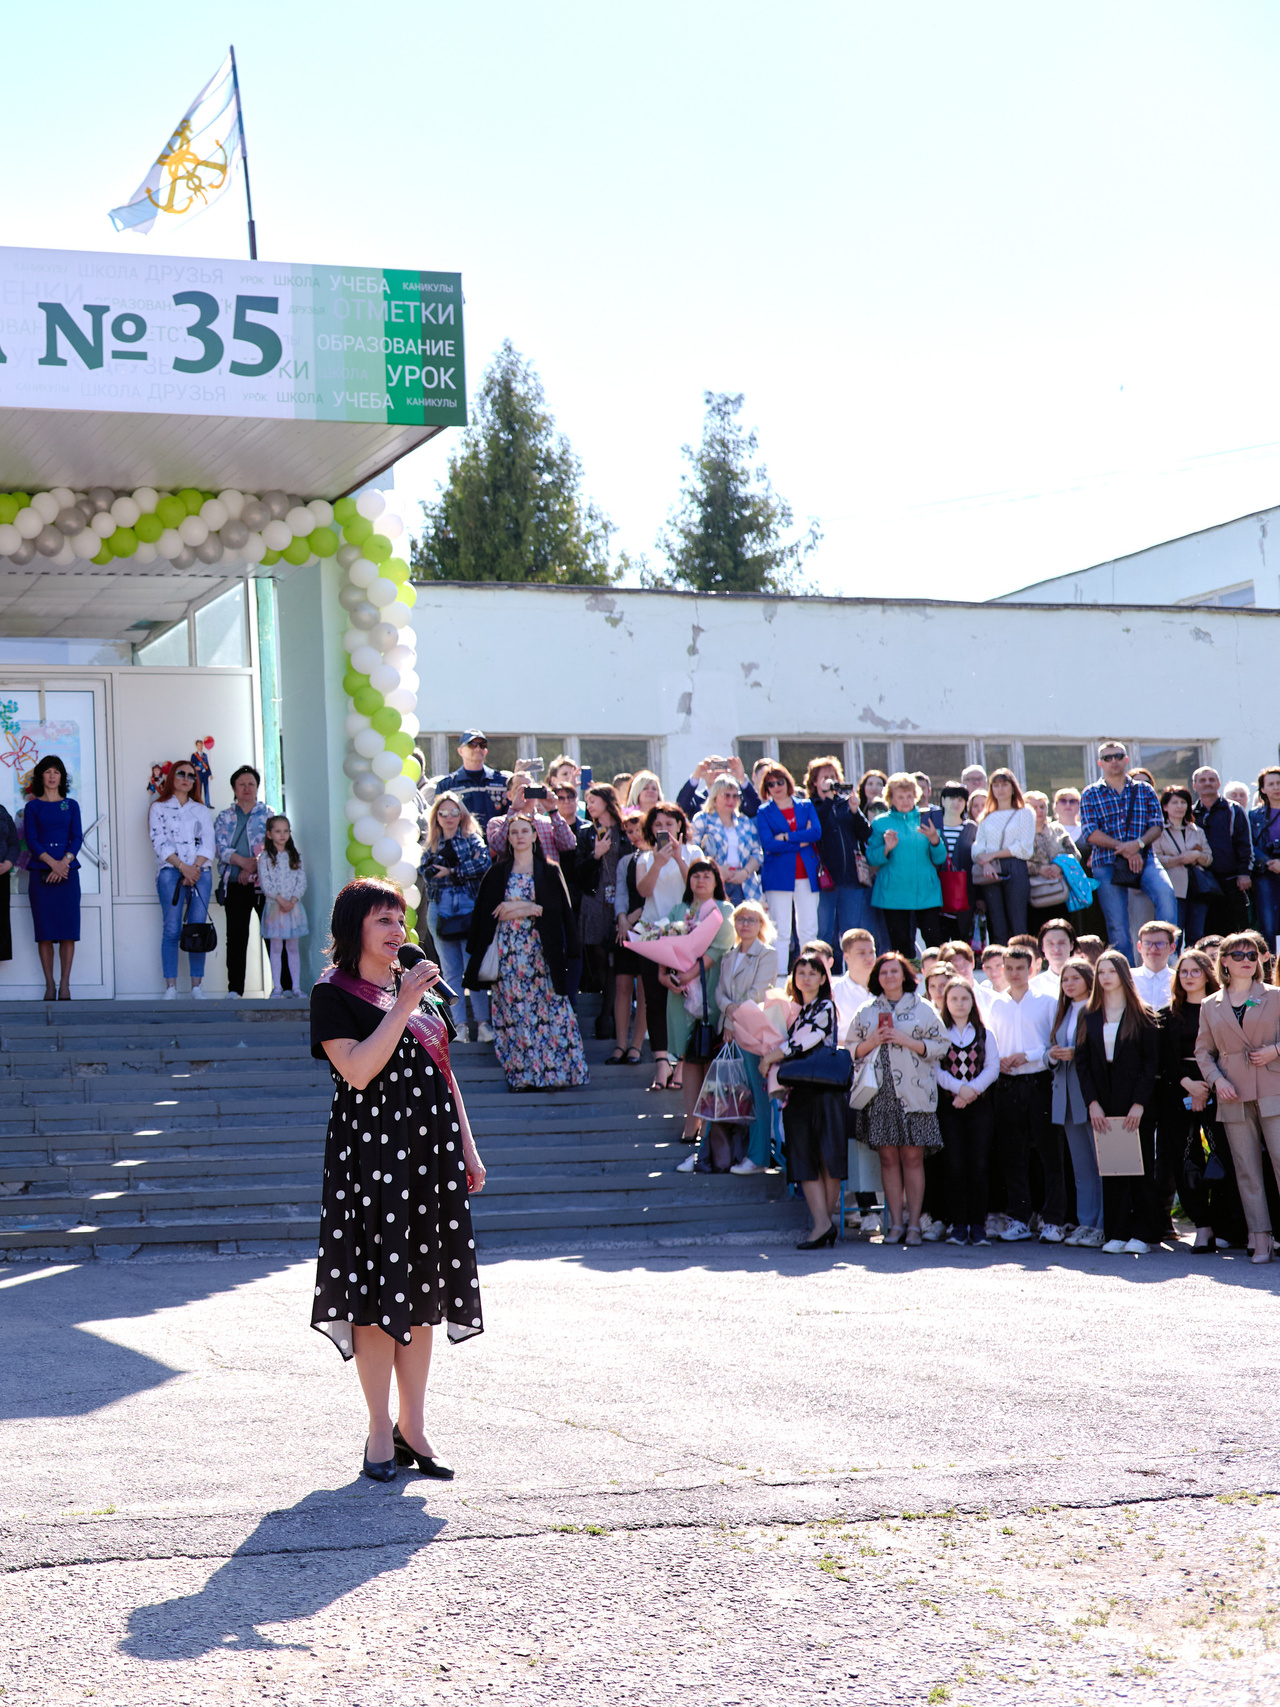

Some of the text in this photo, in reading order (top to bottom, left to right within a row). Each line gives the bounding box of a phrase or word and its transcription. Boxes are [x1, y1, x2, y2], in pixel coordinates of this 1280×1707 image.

[78, 263, 139, 280] ШКОЛА
[144, 264, 224, 285] ДРУЗЬЯ
[239, 275, 265, 285] УРОК
[273, 274, 321, 289] ШКОЛА
[330, 274, 391, 294] УЧЕБА
[402, 281, 454, 294] КАНИКУЛЫ
[333, 297, 455, 326] ОТМЕТКИ
[37, 301, 149, 371] №
[172, 290, 283, 378] 35
[317, 333, 456, 358] ОБРАЗОВАНИЕ
[387, 365, 457, 390] УРОК
[80, 383, 141, 399] ШКОЛА
[147, 382, 227, 403] ДРУЗЬЯ
[276, 391, 324, 405] ШКОЛА
[333, 391, 394, 409] УЧЕБА
[406, 396, 458, 409] КАНИКУЛЫ
